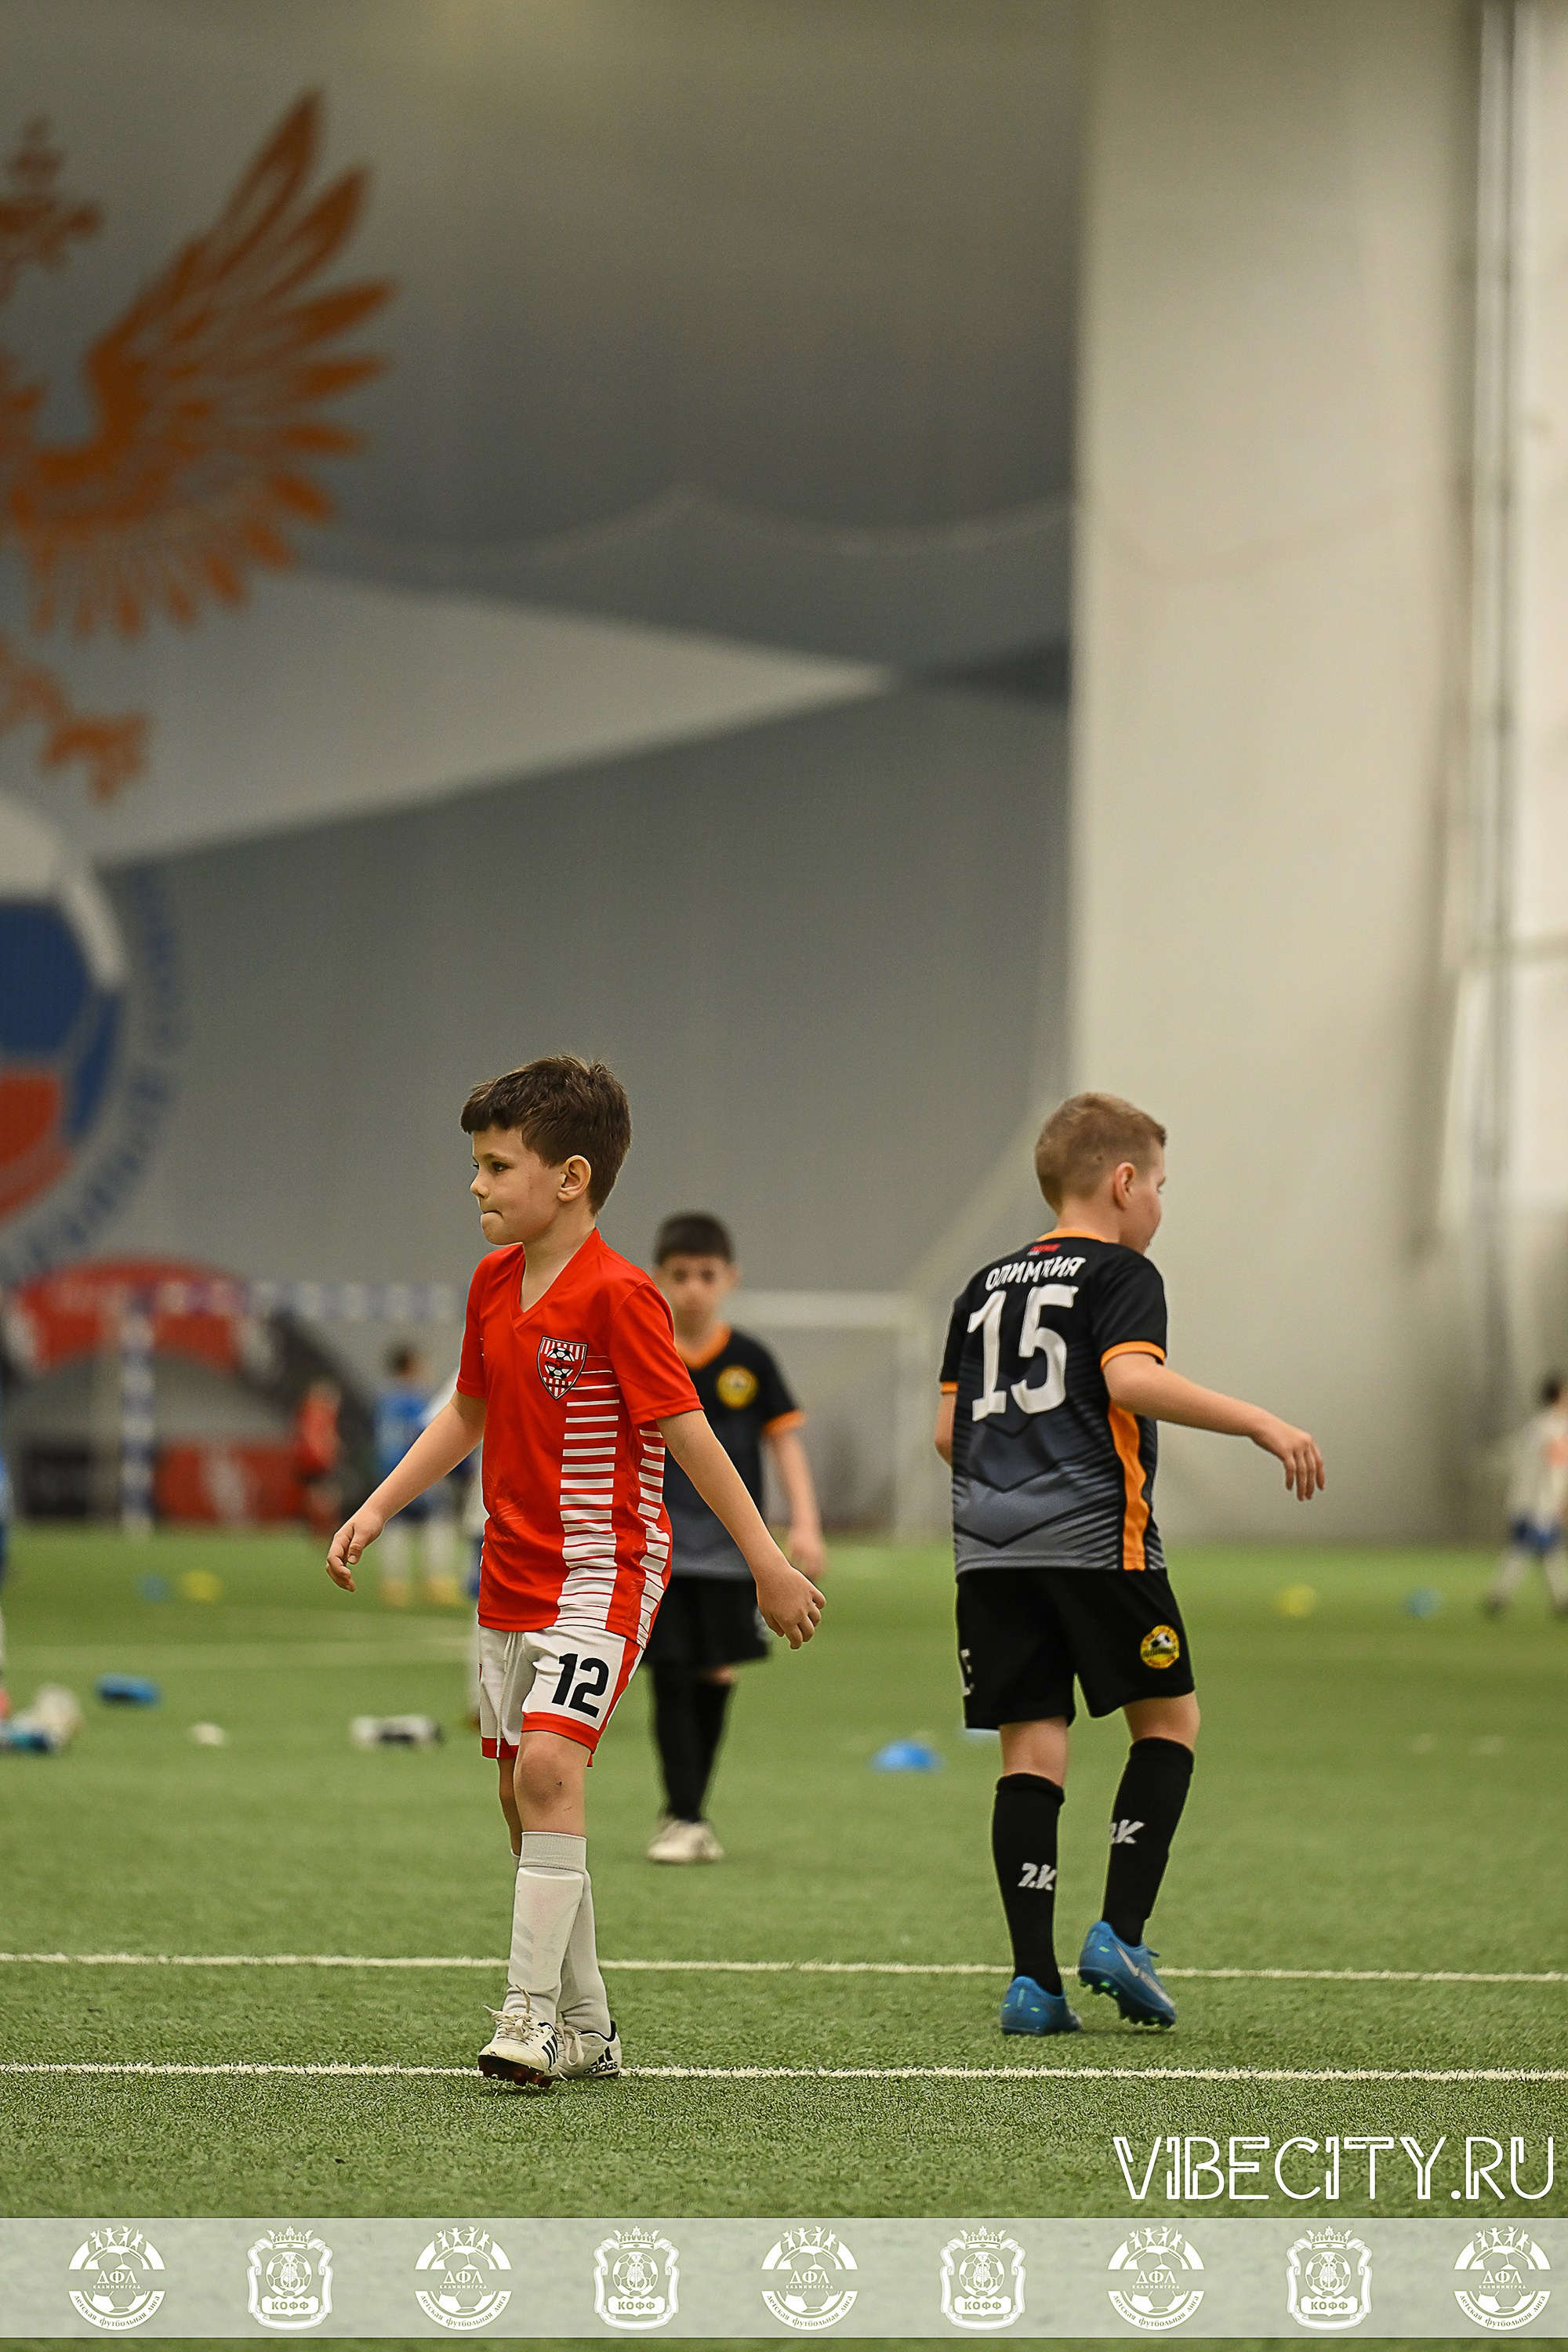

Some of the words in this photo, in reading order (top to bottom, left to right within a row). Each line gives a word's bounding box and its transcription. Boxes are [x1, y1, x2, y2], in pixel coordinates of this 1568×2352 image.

[967, 1283, 1079, 1422] 15
[551, 1653, 610, 1719] 12
[583, 2061, 619, 2074] adidas
